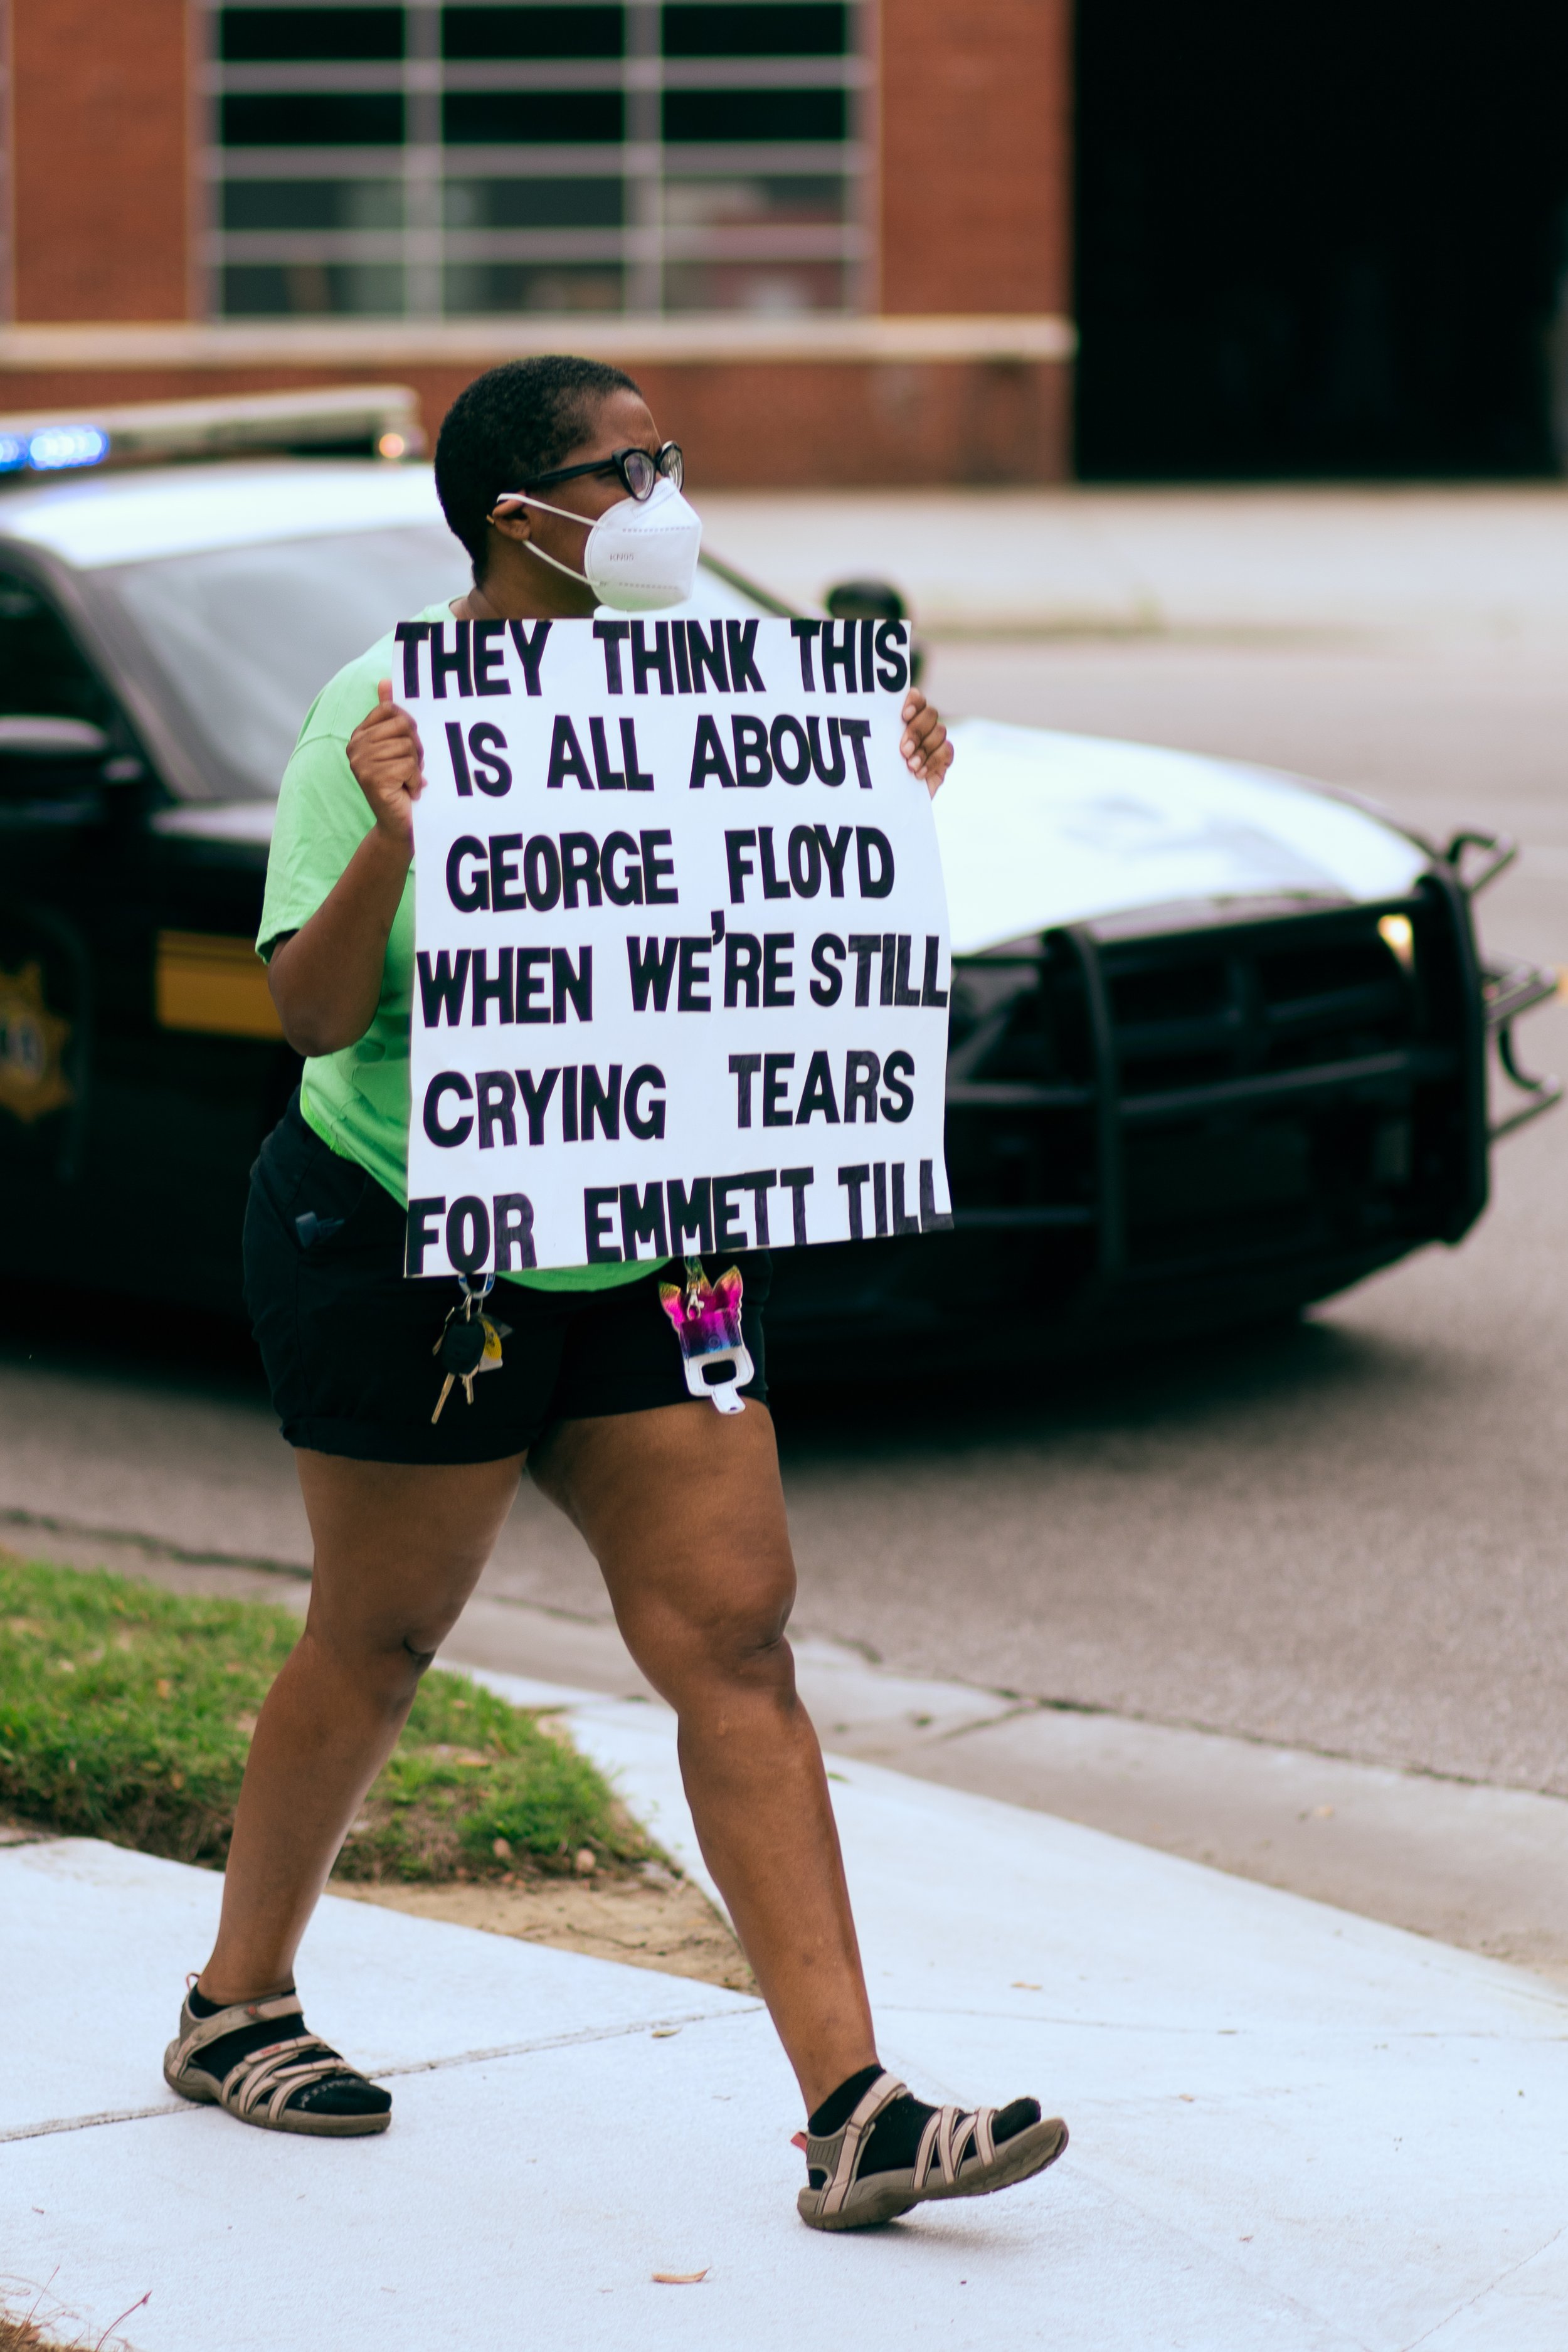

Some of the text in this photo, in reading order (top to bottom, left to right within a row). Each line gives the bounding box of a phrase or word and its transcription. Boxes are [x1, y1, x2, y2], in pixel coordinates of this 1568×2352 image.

[395, 619, 908, 699] THEY THINK THIS
[445, 714, 872, 797] IS ALL ABOUT
[446, 825, 894, 913] GEORGE FLOYD
[416, 911, 948, 1027] WHEN WE'RE STILL
[423, 1051, 914, 1149] CRYING TEARS
[406, 1159, 954, 1275] FOR EMMETT TILL
